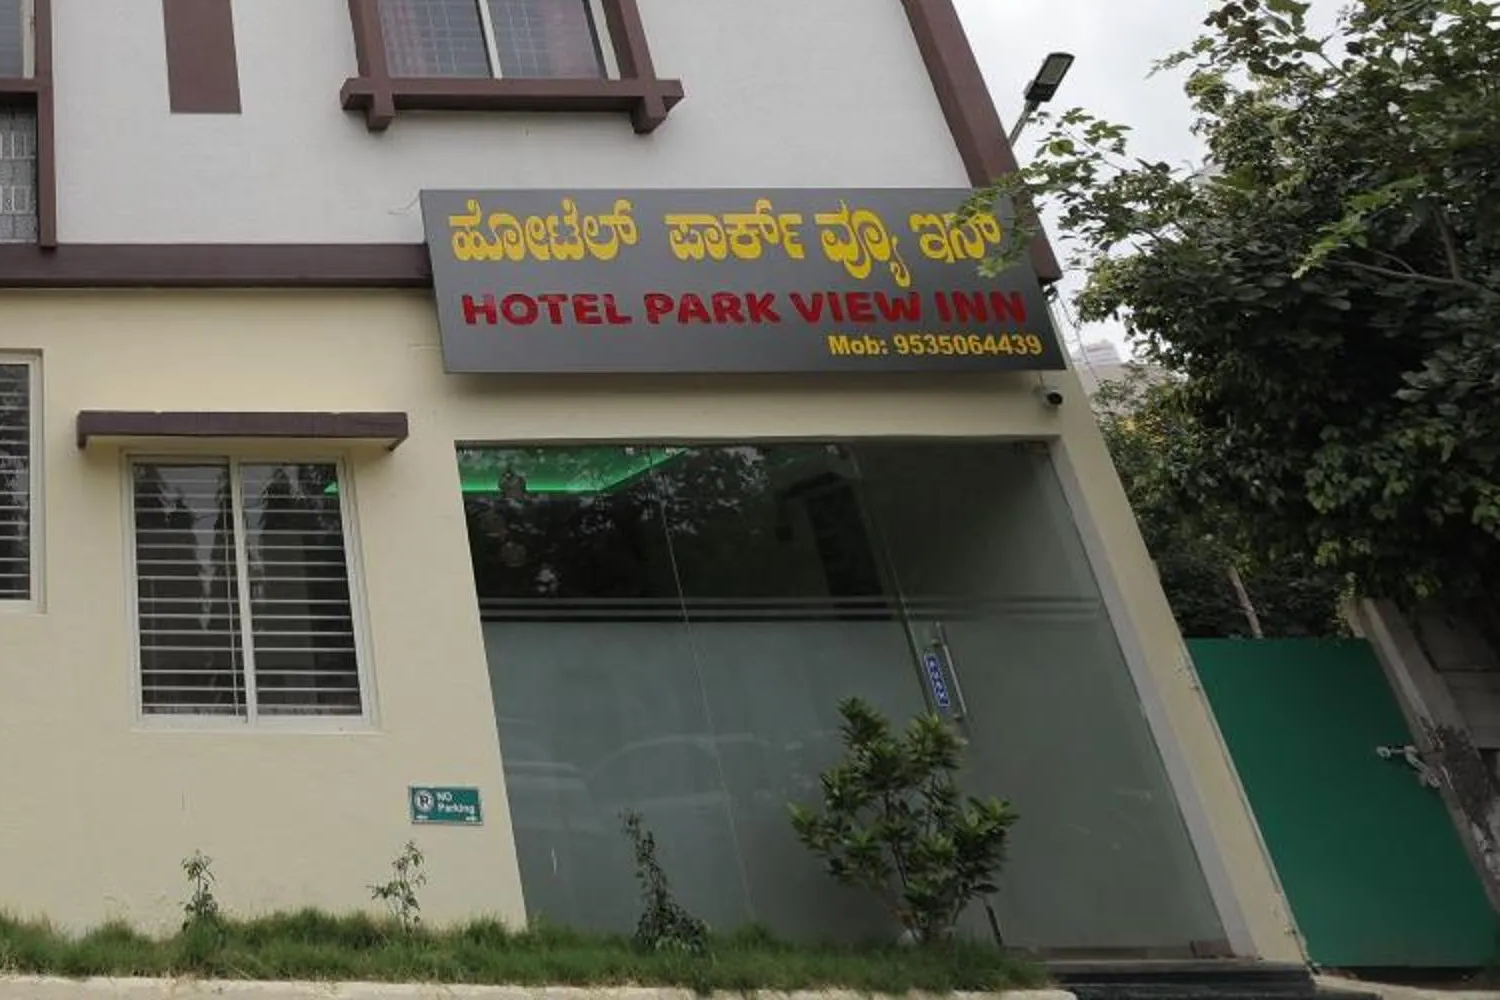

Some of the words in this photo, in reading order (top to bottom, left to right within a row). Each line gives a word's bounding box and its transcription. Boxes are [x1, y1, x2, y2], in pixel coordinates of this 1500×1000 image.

[448, 198, 640, 262] ಹೋಟೆಲ್
[663, 197, 806, 262] ಪಾರ್ಕ್
[460, 292, 633, 326] HOTEL
[643, 292, 782, 326] PARK
[788, 290, 923, 325] VIEW
[934, 290, 1028, 325] INN
[827, 335, 889, 356] Mob:
[892, 334, 1045, 357] 9535064439
[436, 791, 453, 801] NO
[437, 802, 476, 815] Parking
